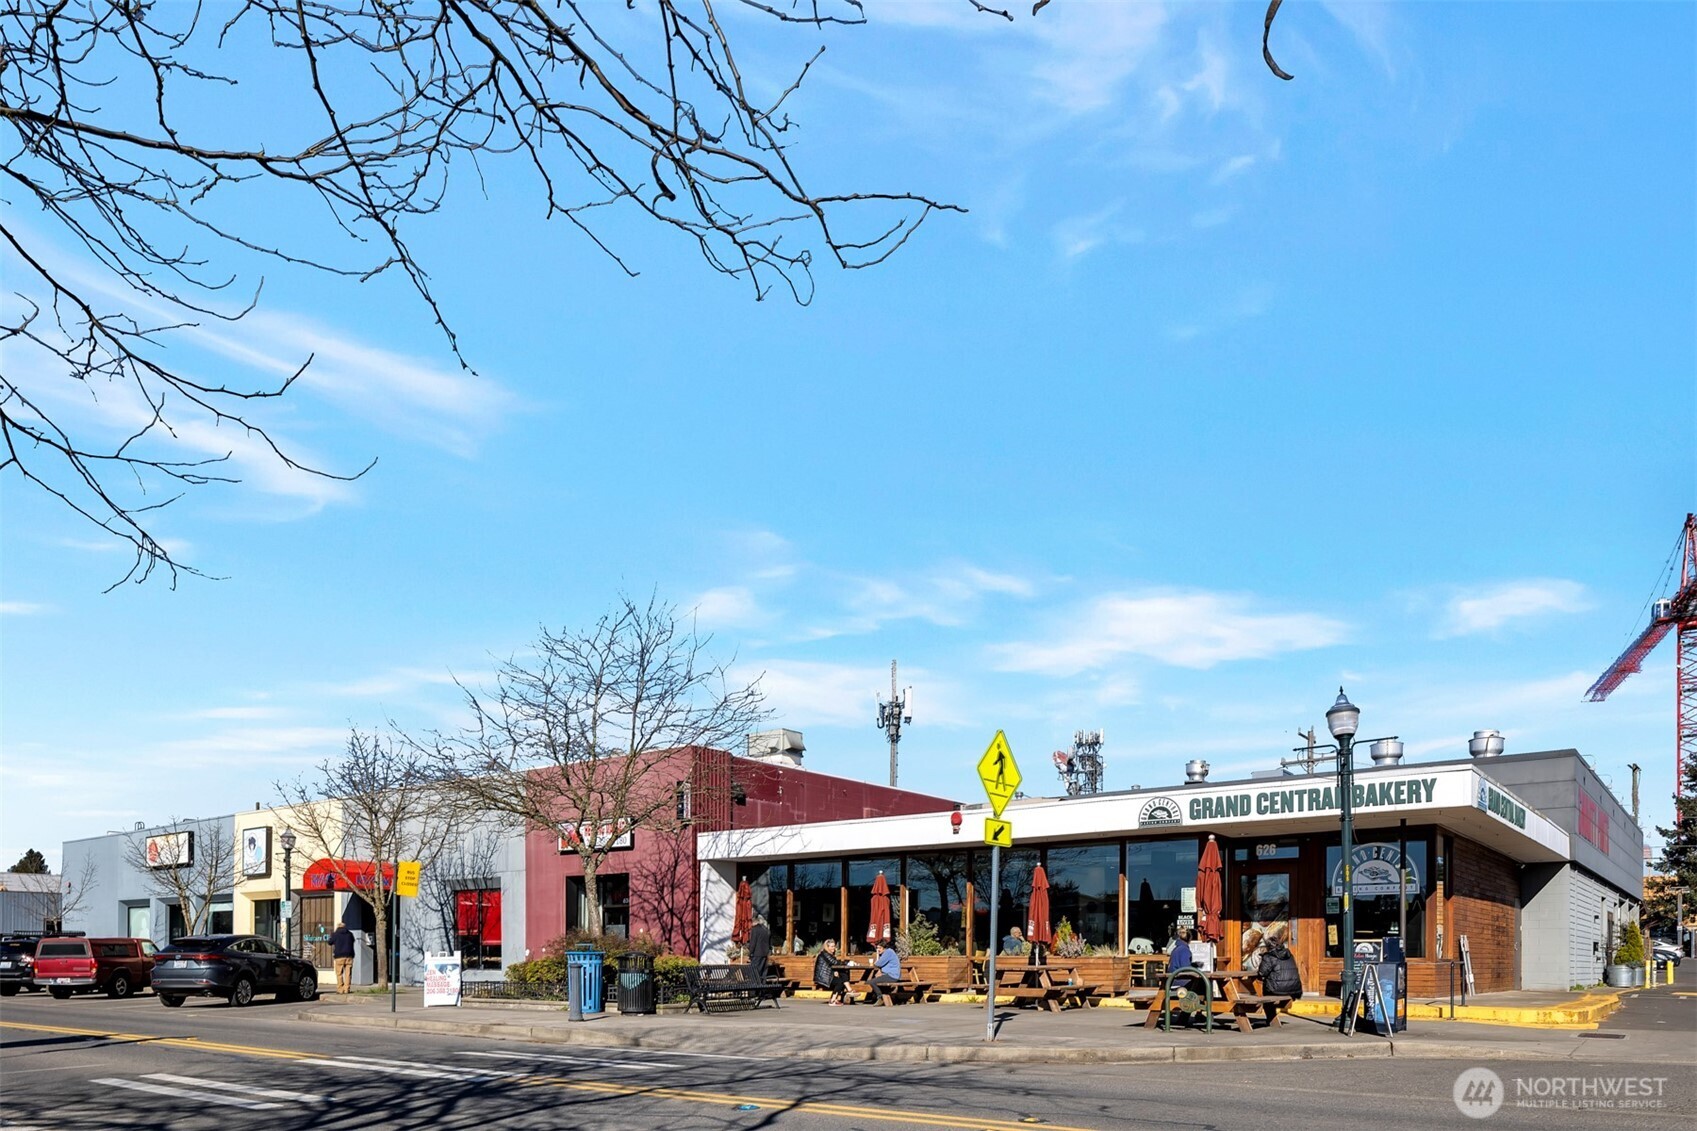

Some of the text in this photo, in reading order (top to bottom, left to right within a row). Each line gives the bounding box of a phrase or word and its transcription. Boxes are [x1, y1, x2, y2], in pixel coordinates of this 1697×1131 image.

[1189, 794, 1251, 820] GRAND
[1351, 778, 1437, 808] BAKERY
[1255, 843, 1276, 857] 626
